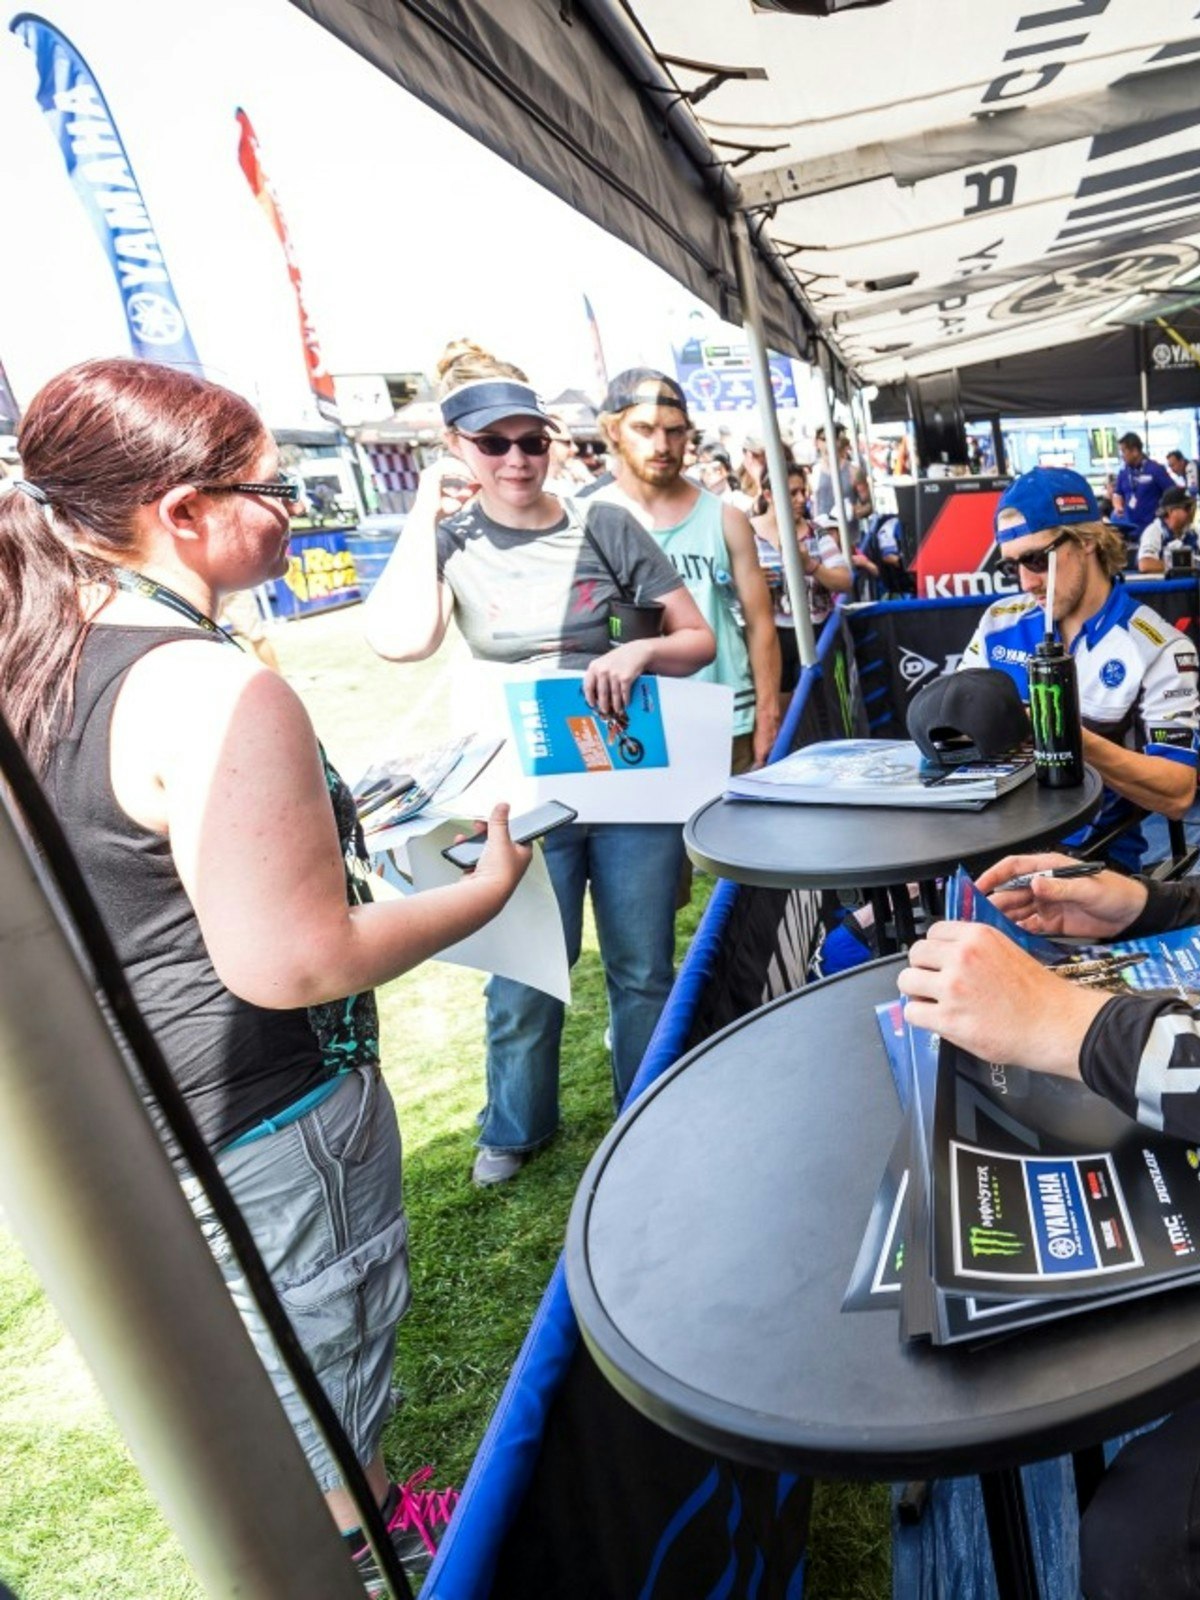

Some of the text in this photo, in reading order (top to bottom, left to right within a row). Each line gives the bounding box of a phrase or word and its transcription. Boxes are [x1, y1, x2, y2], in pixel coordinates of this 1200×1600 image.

[54, 84, 168, 289] YAMAHA
[975, 1166, 995, 1228] MONSTER
[990, 1176, 1002, 1219] ENERGY
[1036, 1172, 1072, 1238] YAMAHA
[1142, 1149, 1172, 1205] DUNLOP
